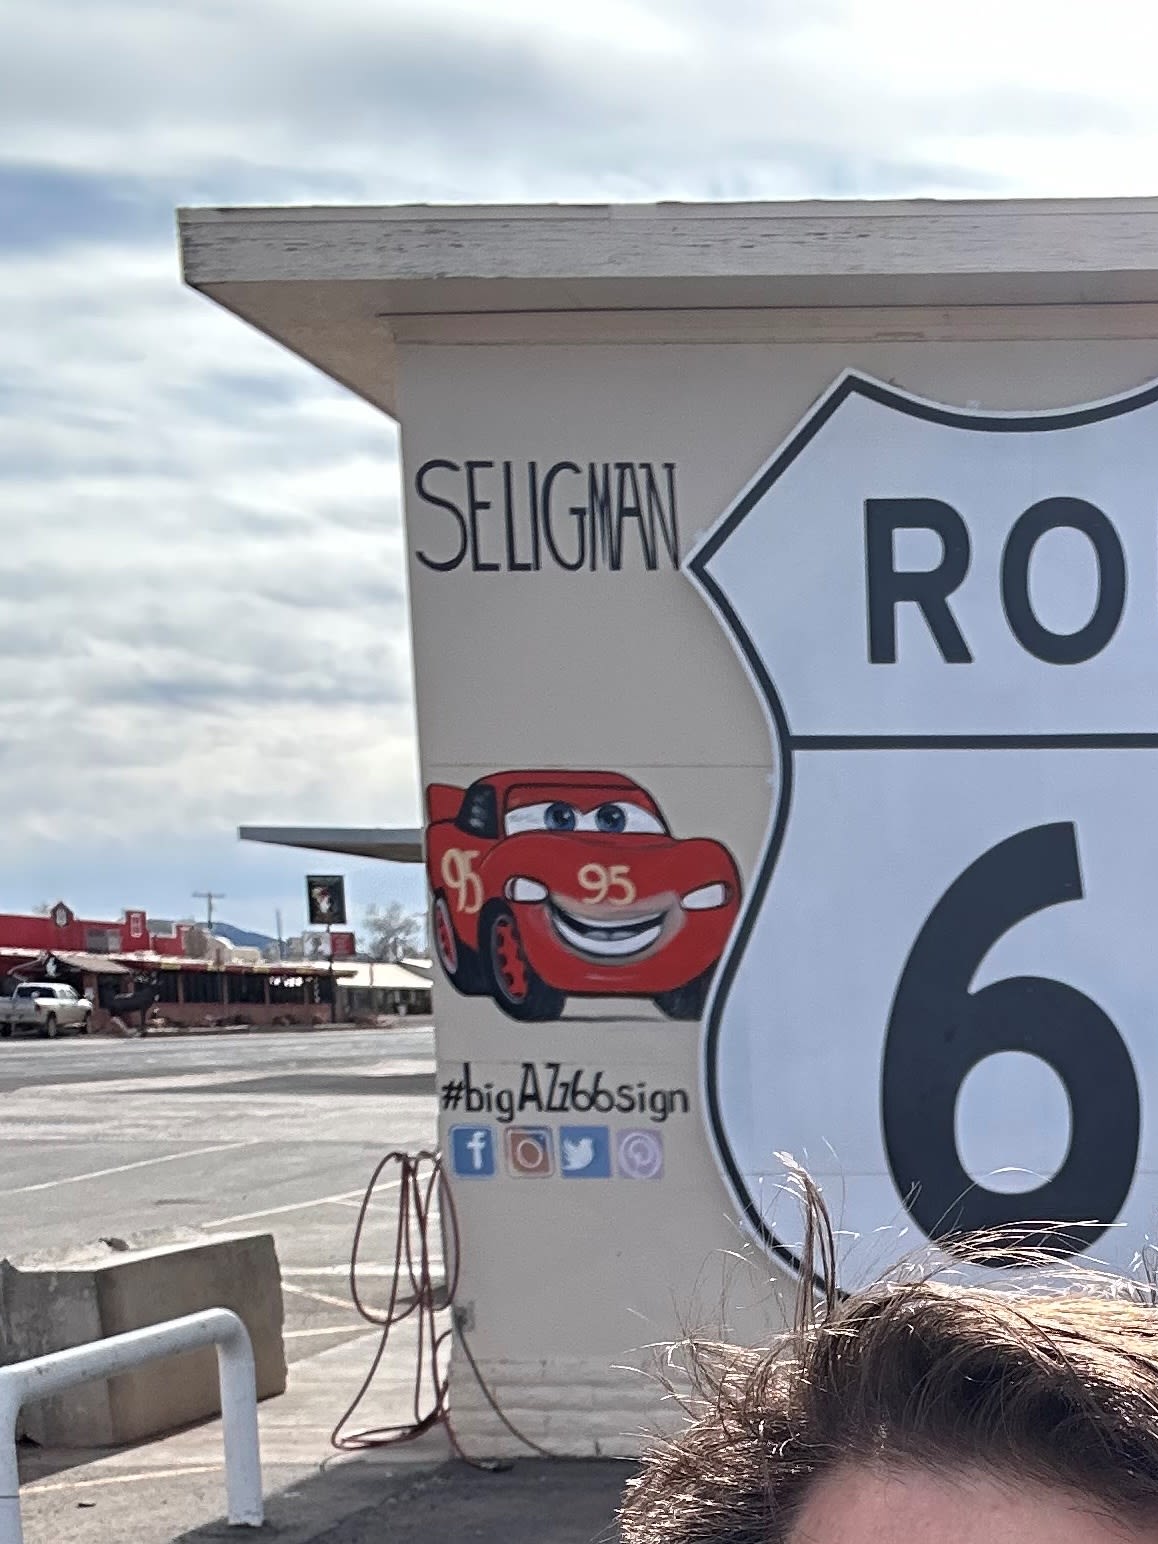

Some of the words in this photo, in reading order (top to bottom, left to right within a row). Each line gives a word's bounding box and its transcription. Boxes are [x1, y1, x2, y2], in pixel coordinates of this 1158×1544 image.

[414, 459, 680, 572] SELIGMAN
[440, 848, 485, 915] 95
[577, 862, 637, 907] 95
